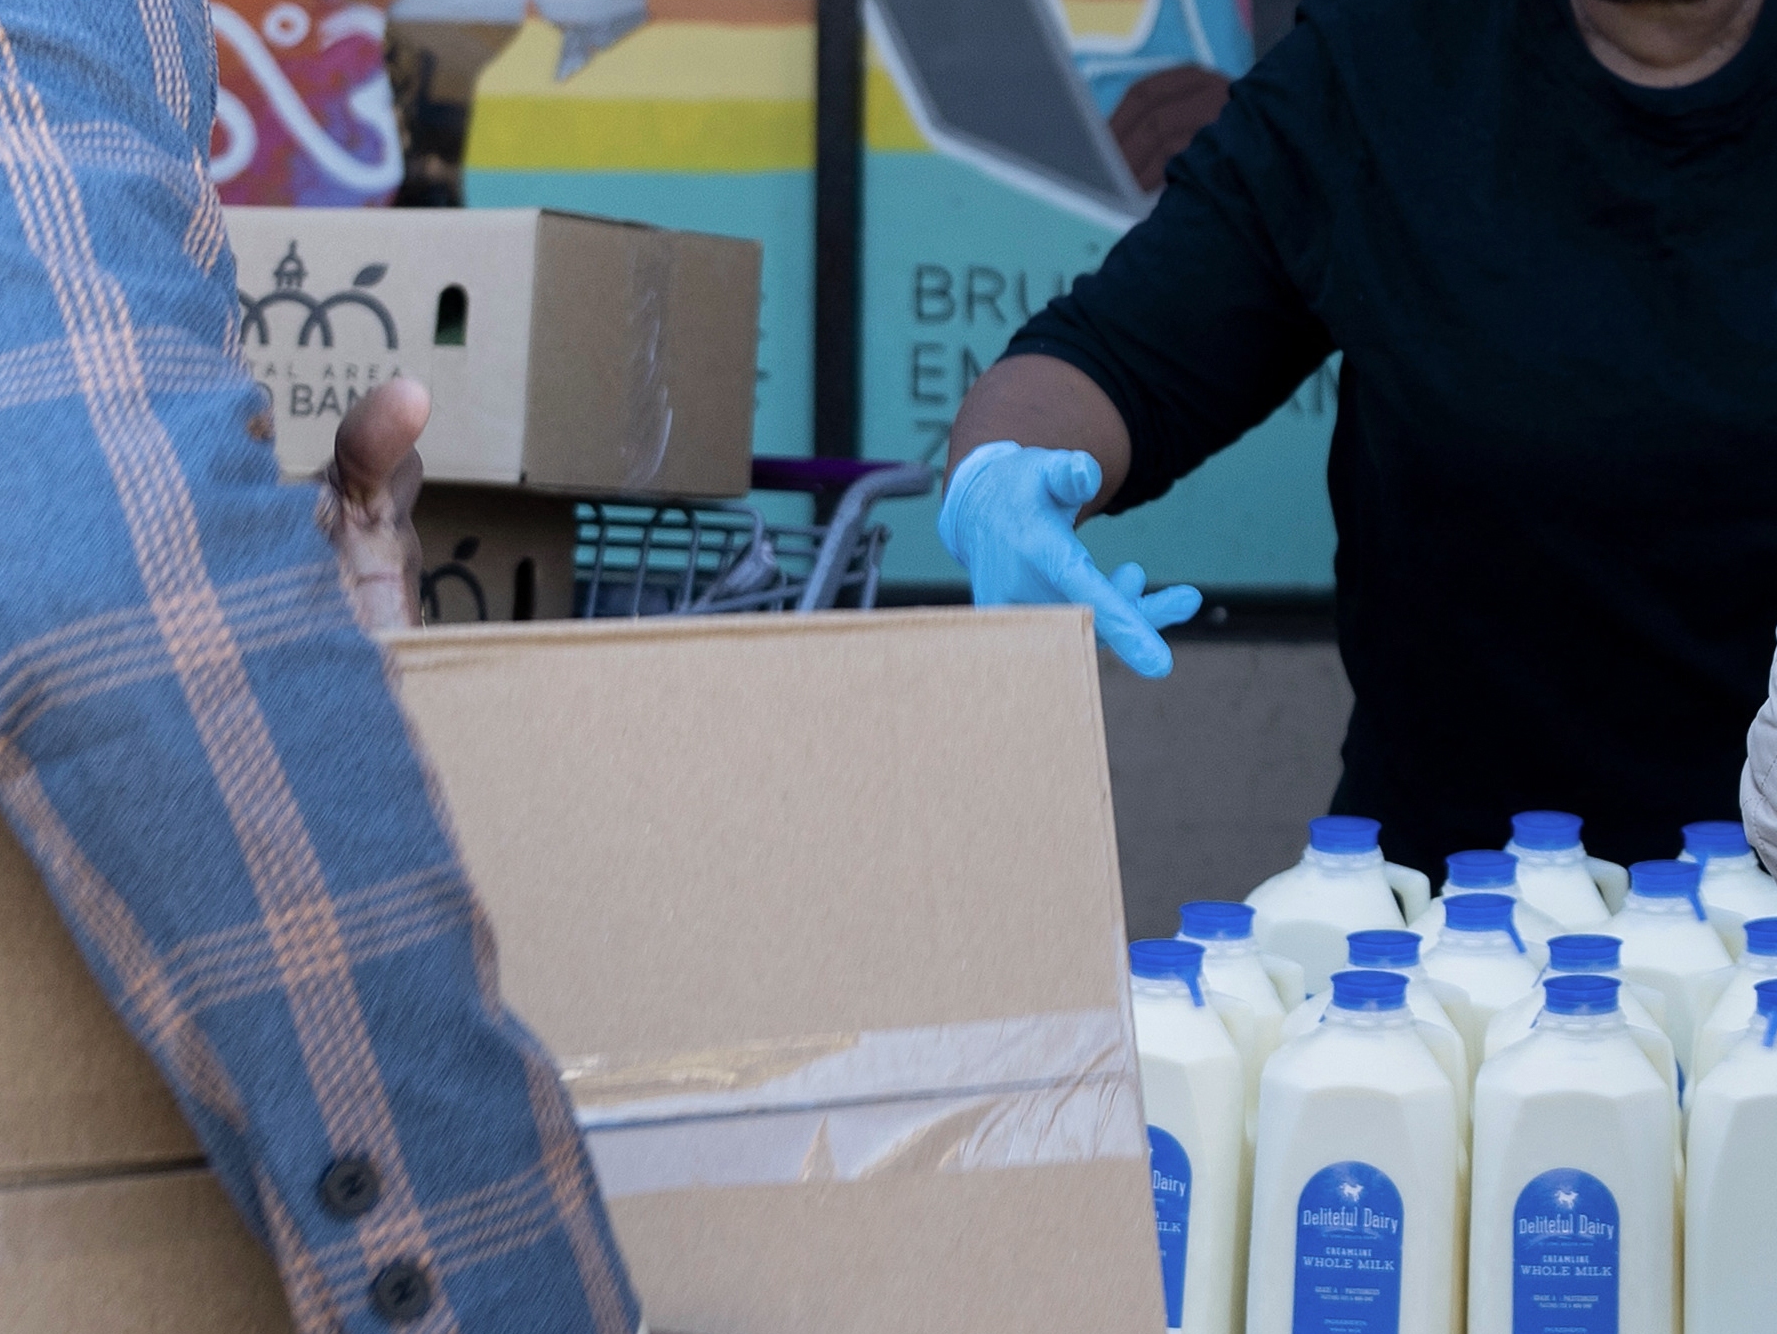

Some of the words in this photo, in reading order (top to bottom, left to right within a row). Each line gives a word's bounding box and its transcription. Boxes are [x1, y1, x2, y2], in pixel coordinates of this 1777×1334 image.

[324, 363, 403, 379] AREA
[1153, 1170, 1187, 1197] Dairy
[1157, 1221, 1182, 1233] ILK
[1303, 1206, 1358, 1227] Deliteful
[1363, 1207, 1398, 1235] Dairy
[1519, 1214, 1574, 1234] Deliteful
[1579, 1214, 1614, 1240] Dairy
[1325, 1247, 1372, 1257] CREAMLINE
[1543, 1255, 1589, 1263] CREAMLINE
[1303, 1256, 1353, 1269] WHOLE
[1357, 1259, 1395, 1271] MILK
[1521, 1265, 1570, 1276] WHOLE
[1574, 1266, 1612, 1277] MILK
